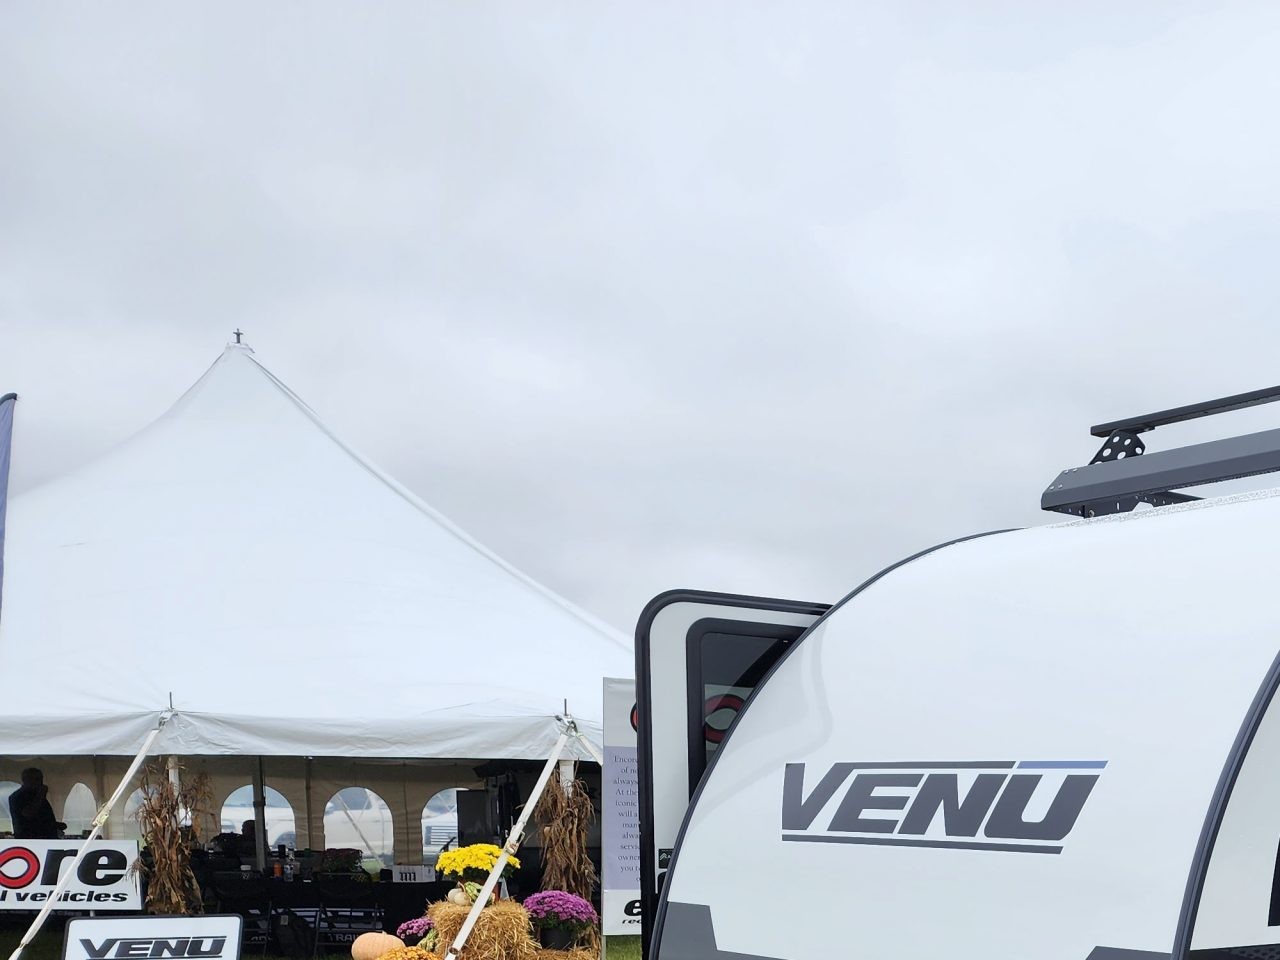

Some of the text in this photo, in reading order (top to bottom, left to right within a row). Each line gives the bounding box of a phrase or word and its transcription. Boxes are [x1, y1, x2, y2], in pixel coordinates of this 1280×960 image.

[782, 760, 1109, 841] VENU
[16, 890, 128, 902] vehicles
[79, 936, 227, 959] VENU
